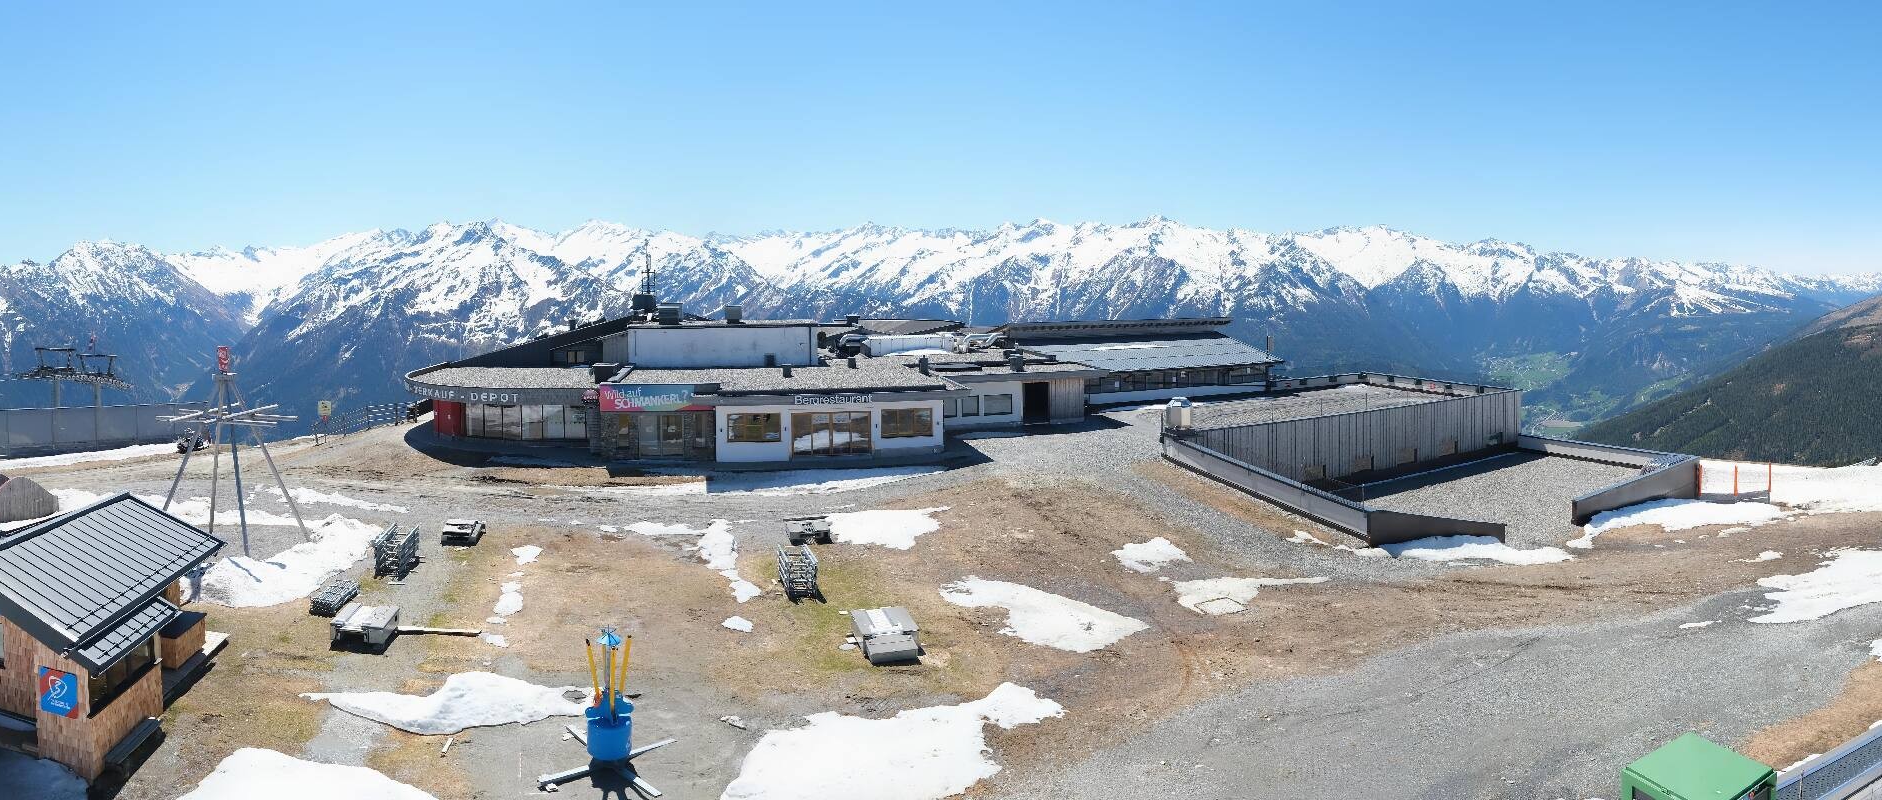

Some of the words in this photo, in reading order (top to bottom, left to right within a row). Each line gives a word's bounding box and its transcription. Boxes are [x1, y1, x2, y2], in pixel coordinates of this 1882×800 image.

[470, 392, 519, 403] DEPOT
[604, 389, 624, 400] Wild
[626, 386, 641, 397] auf
[614, 389, 689, 409] SCHMANKERL?
[794, 394, 872, 405] Bergrestaurant
